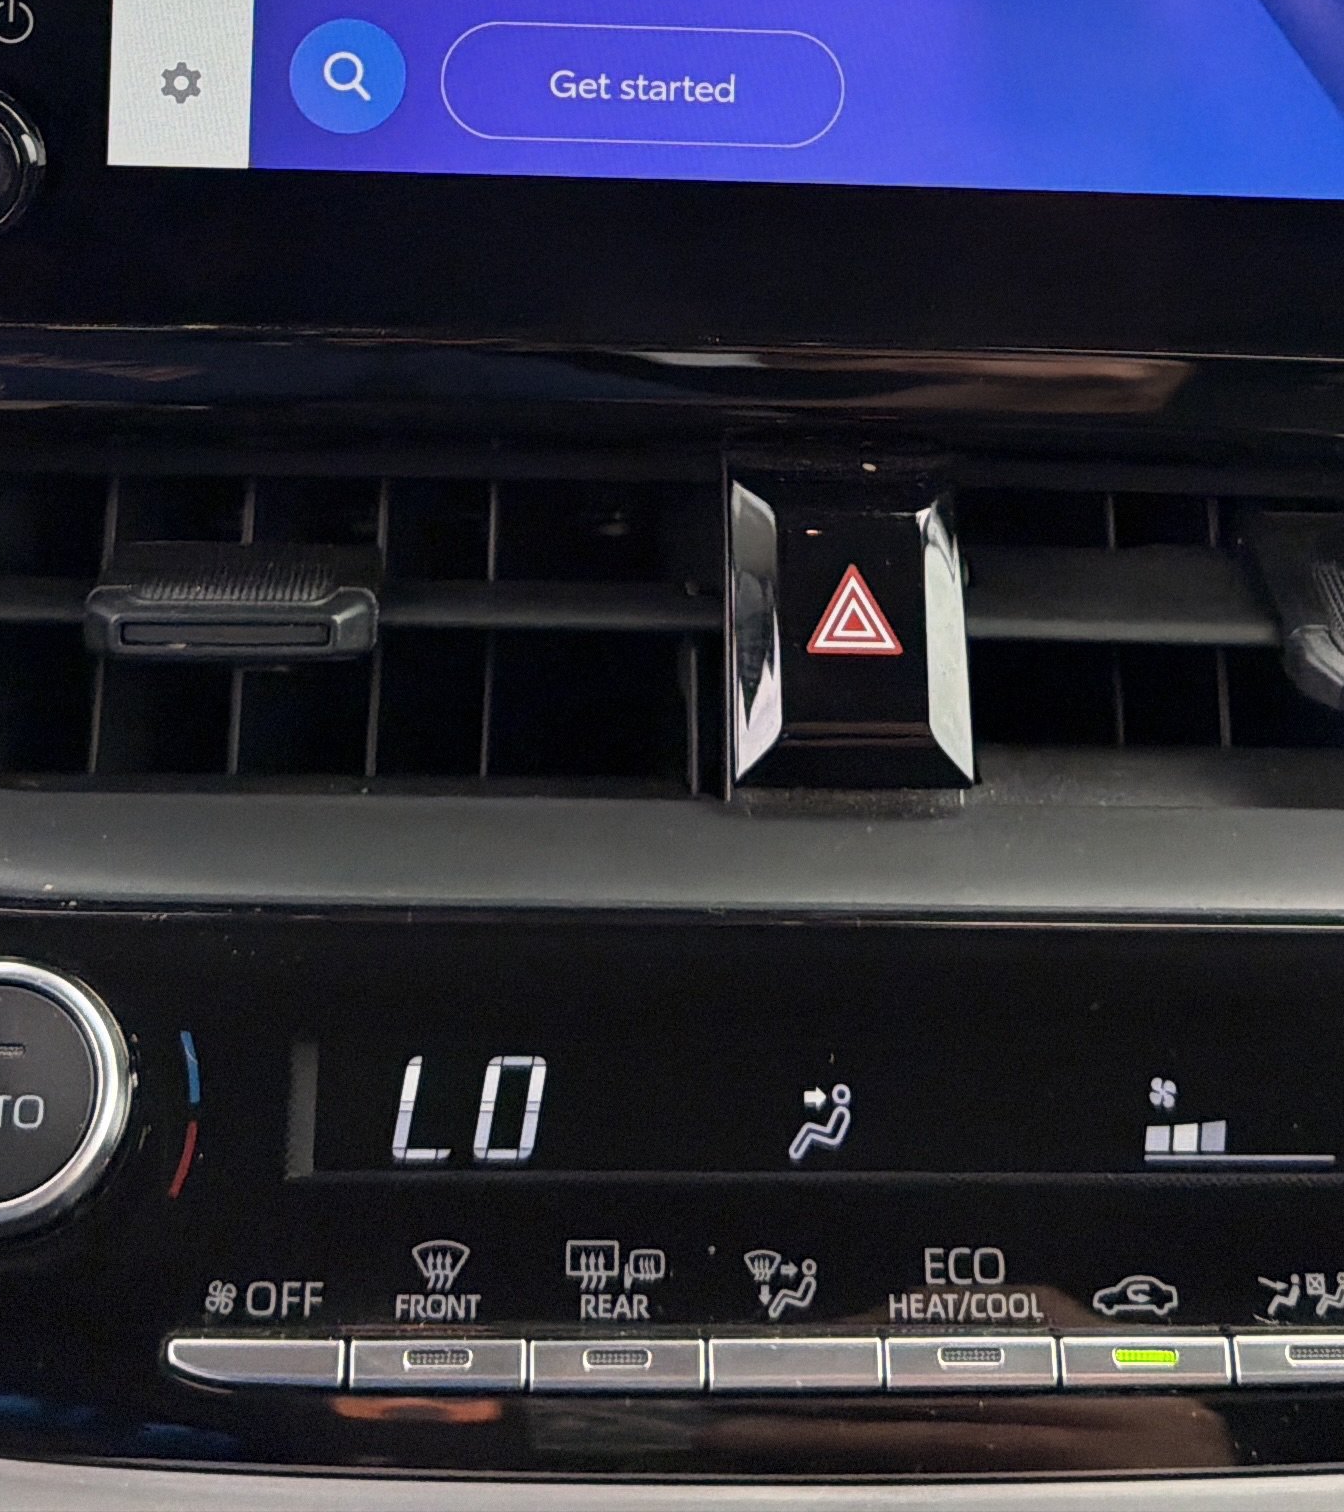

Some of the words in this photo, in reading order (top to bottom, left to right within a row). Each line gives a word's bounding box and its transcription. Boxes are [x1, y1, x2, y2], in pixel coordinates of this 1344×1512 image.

[550, 69, 611, 100] Get
[620, 73, 736, 104] started
[392, 1055, 547, 1160] LO
[924, 1246, 1006, 1286] ECO
[244, 1281, 325, 1318] OFF
[394, 1293, 482, 1320] FRONT
[579, 1293, 651, 1320] REAR
[888, 1291, 1044, 1320] HEAT/COOL
